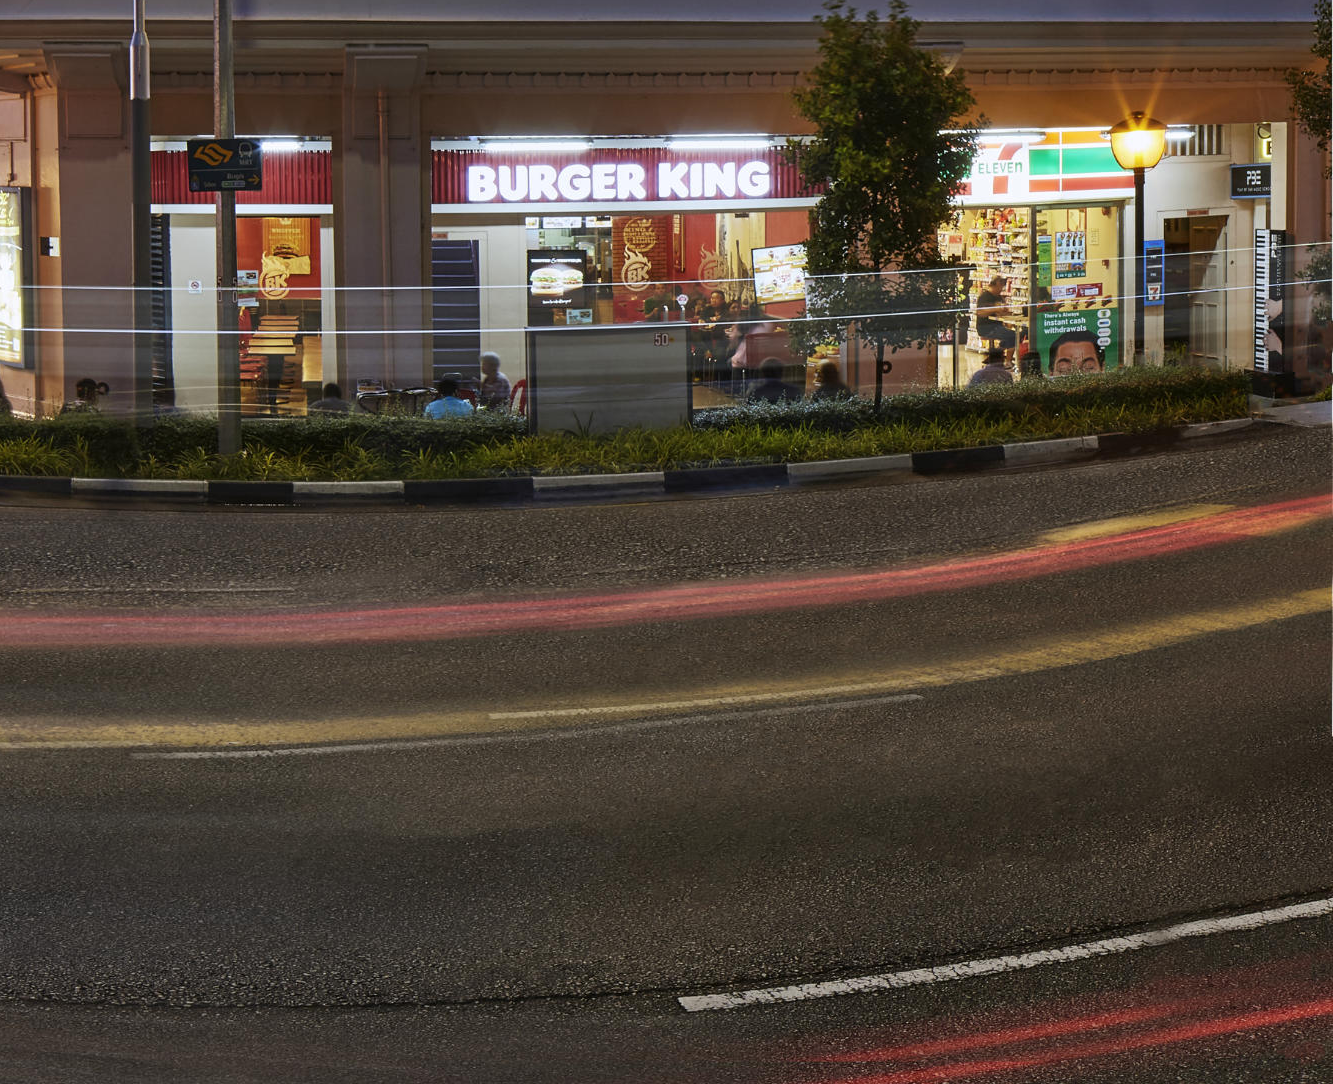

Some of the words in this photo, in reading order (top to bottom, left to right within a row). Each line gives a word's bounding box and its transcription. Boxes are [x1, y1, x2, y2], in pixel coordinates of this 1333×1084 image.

[468, 164, 647, 202] BURGER
[658, 161, 771, 198] KING
[627, 265, 650, 283] BK
[264, 274, 288, 293] BK
[1044, 325, 1087, 334] withdrawals
[654, 334, 669, 346] 50
